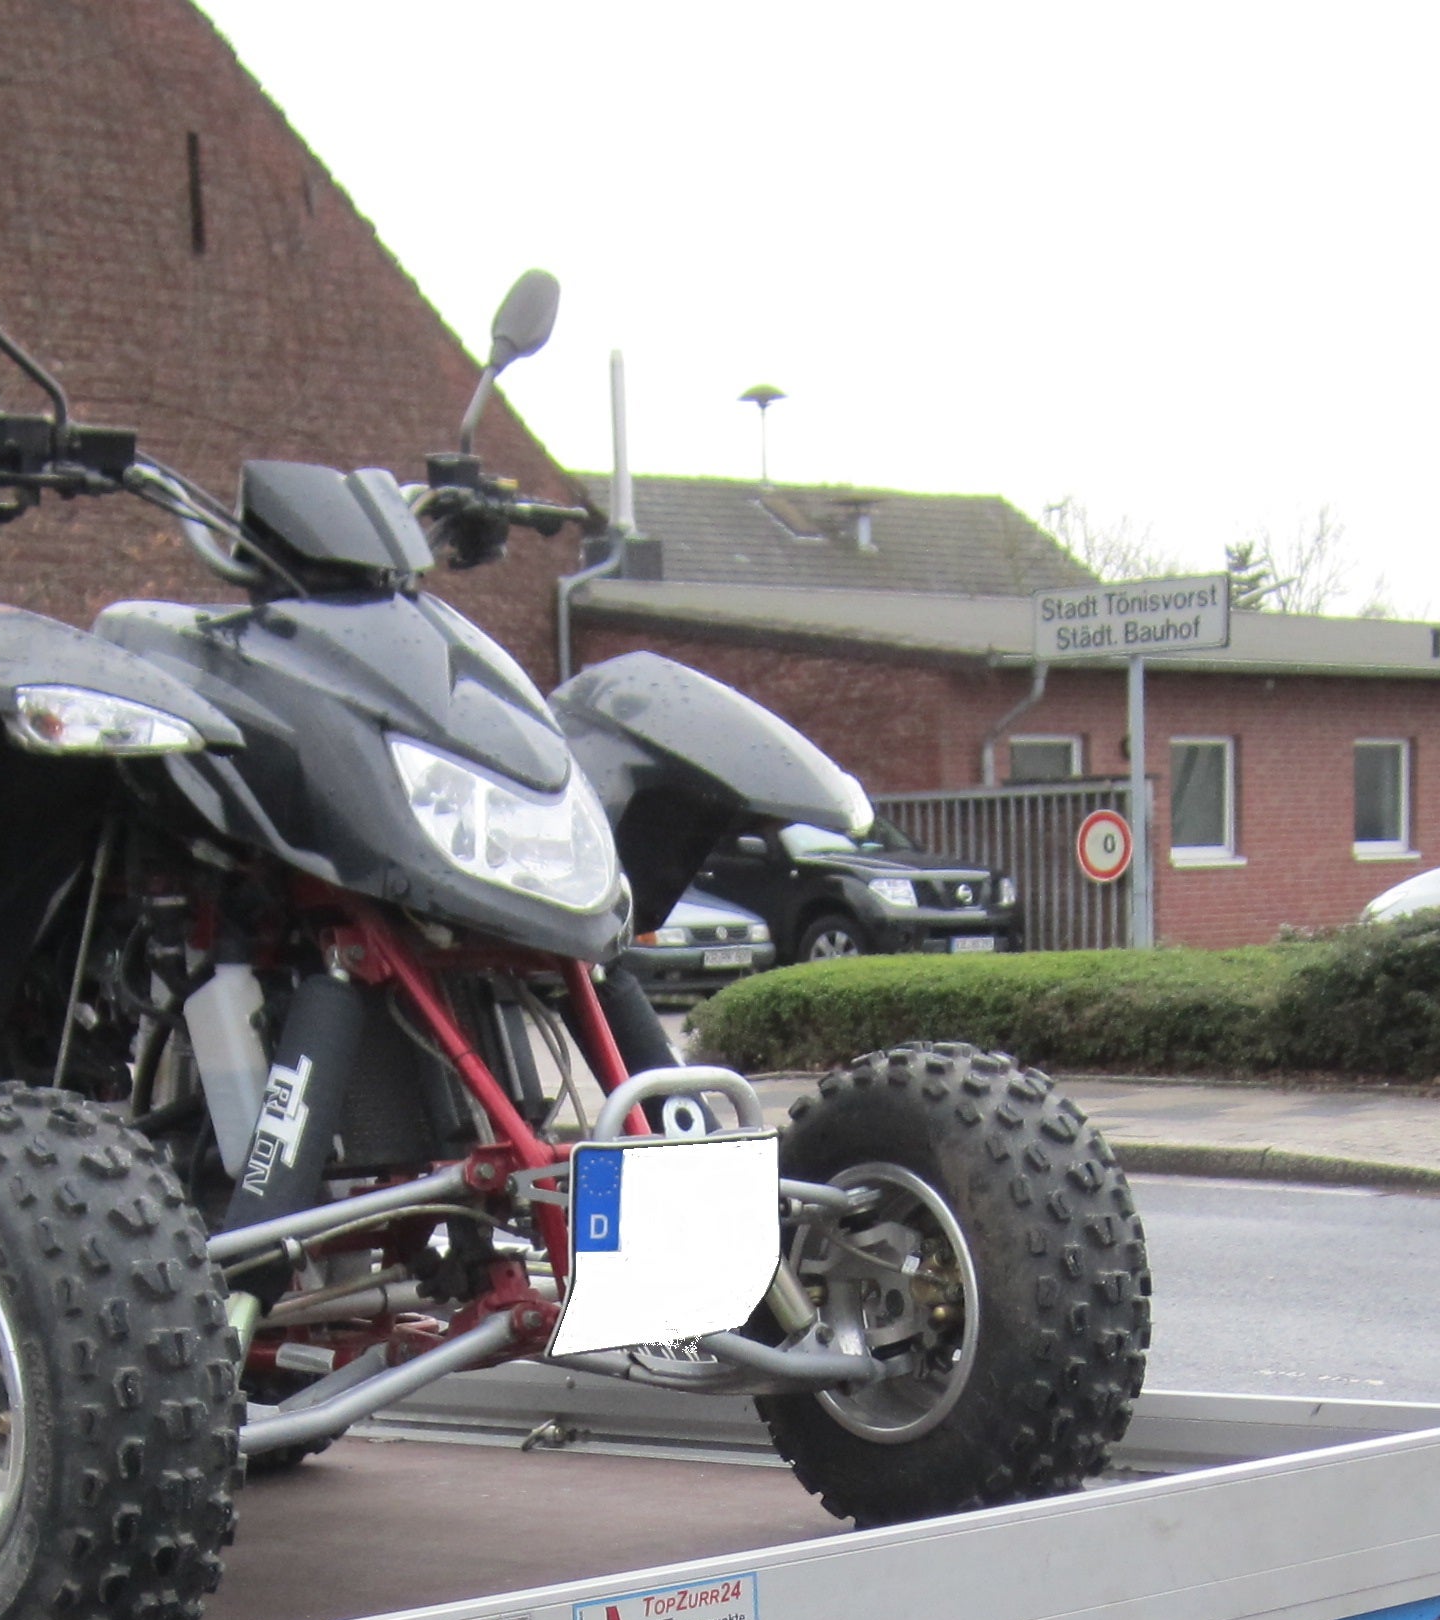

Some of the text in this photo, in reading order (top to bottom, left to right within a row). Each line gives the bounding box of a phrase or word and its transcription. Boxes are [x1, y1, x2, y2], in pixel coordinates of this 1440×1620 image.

[1041, 584, 1217, 621] Stadt Tönisvorst
[1056, 615, 1201, 650] Städt. Bauhof
[589, 1213, 609, 1240] D
